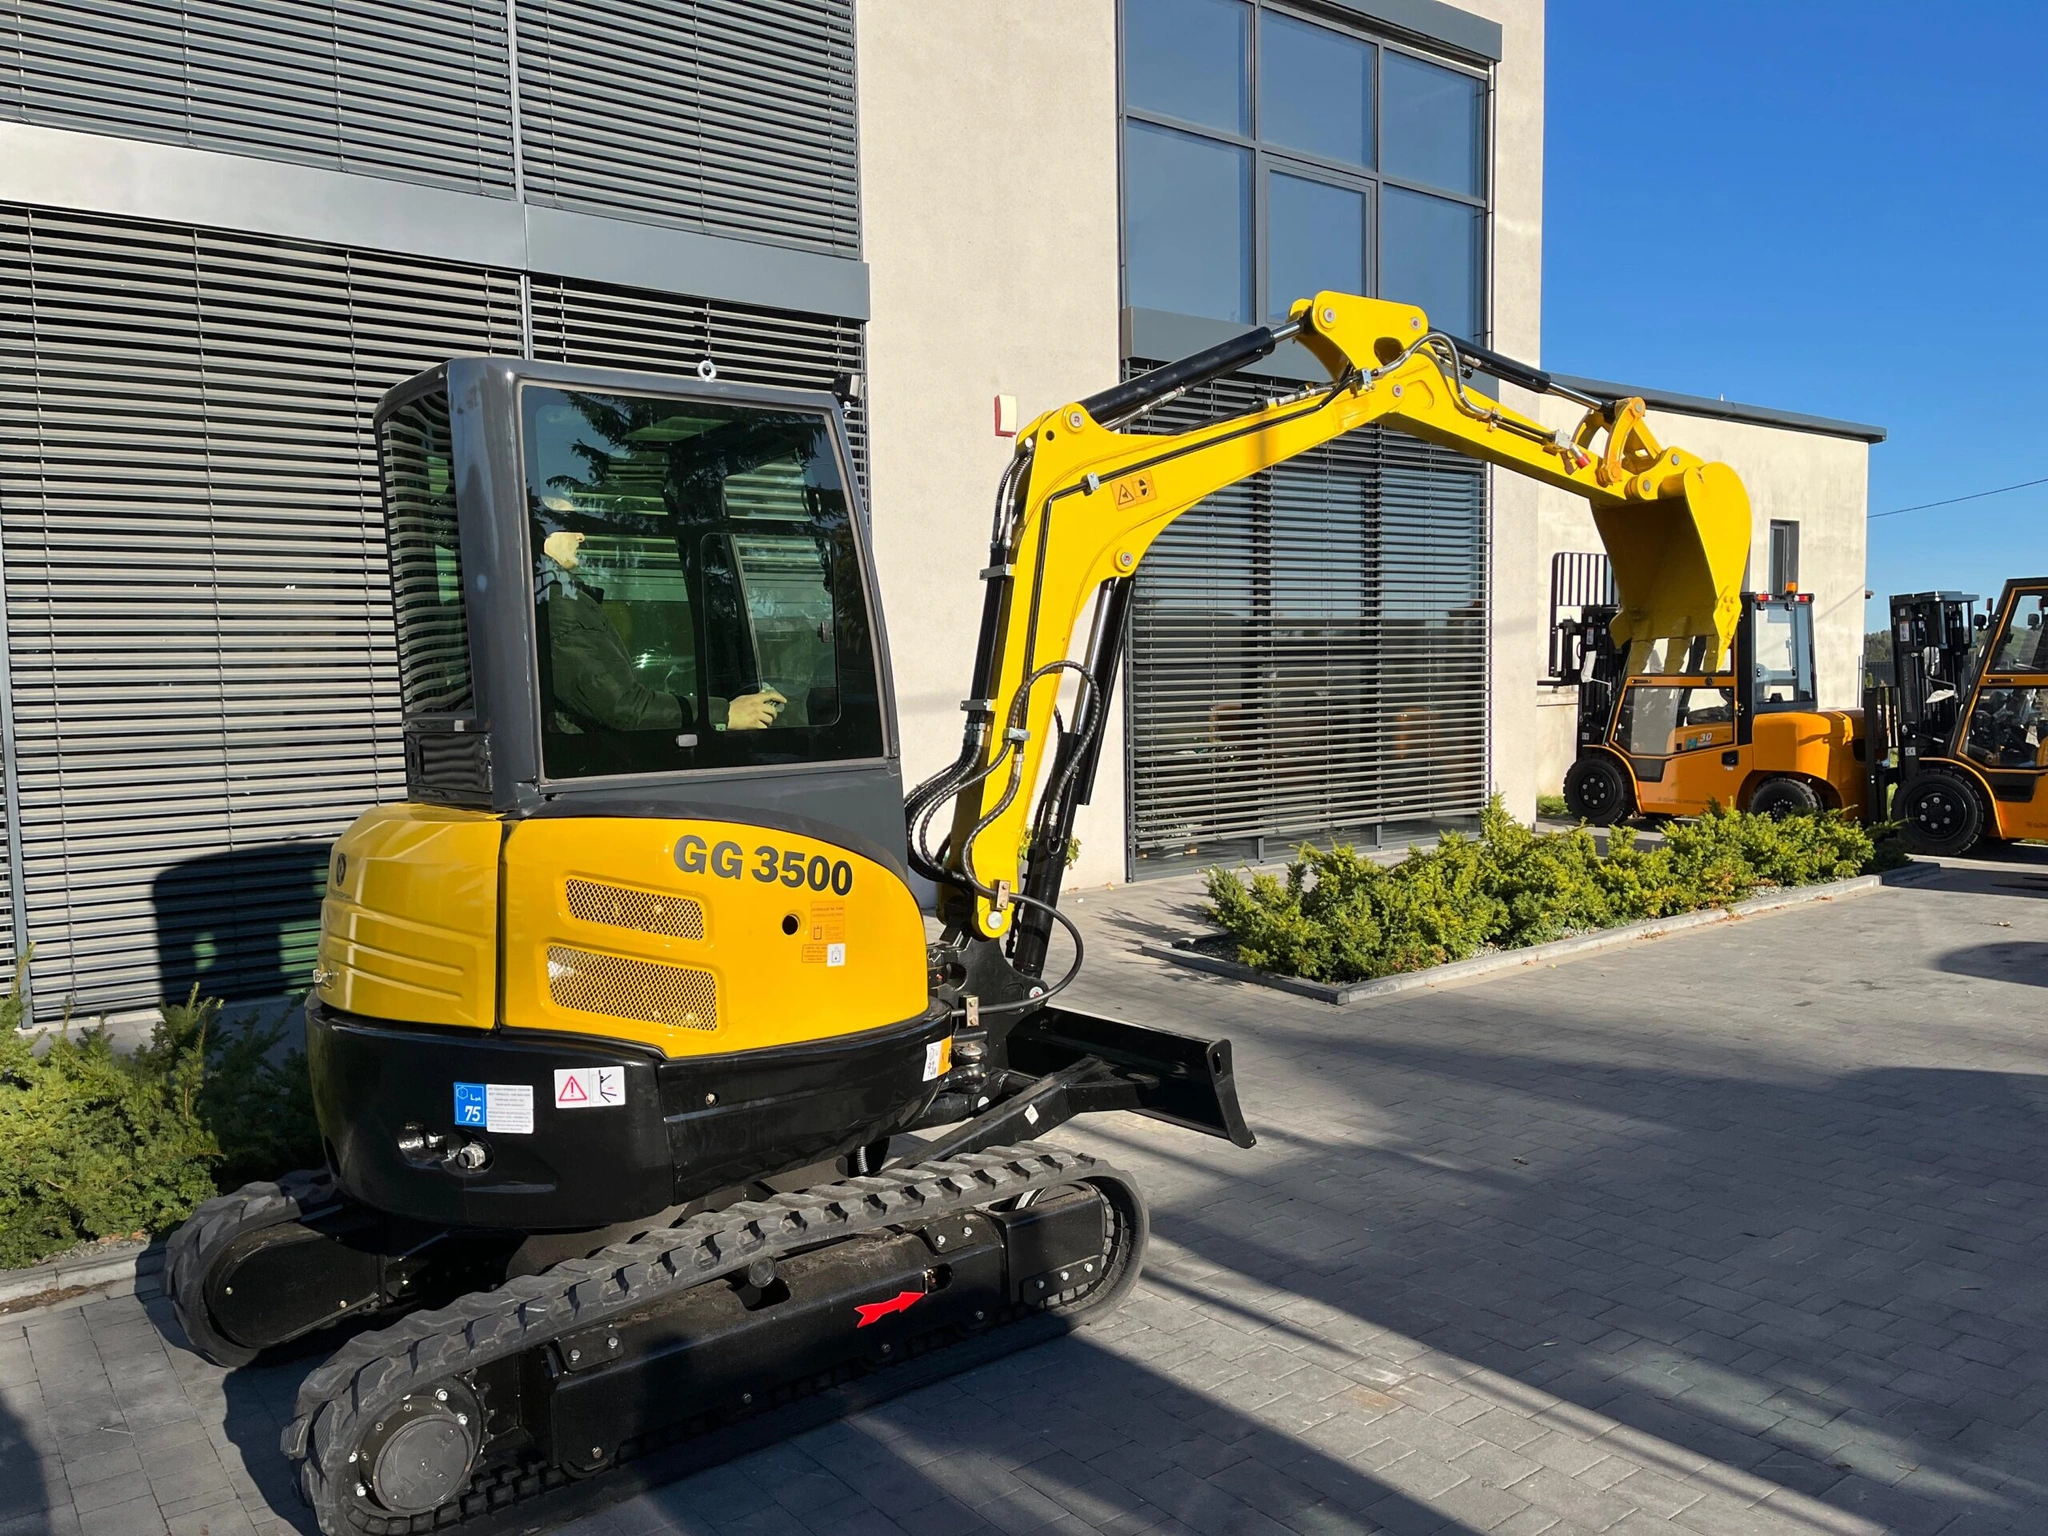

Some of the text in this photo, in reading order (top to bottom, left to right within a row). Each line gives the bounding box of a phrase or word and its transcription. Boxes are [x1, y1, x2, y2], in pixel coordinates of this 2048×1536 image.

[1700, 732, 1713, 741] 30
[673, 834, 853, 896] GG 3500
[464, 1105, 481, 1122] 75
